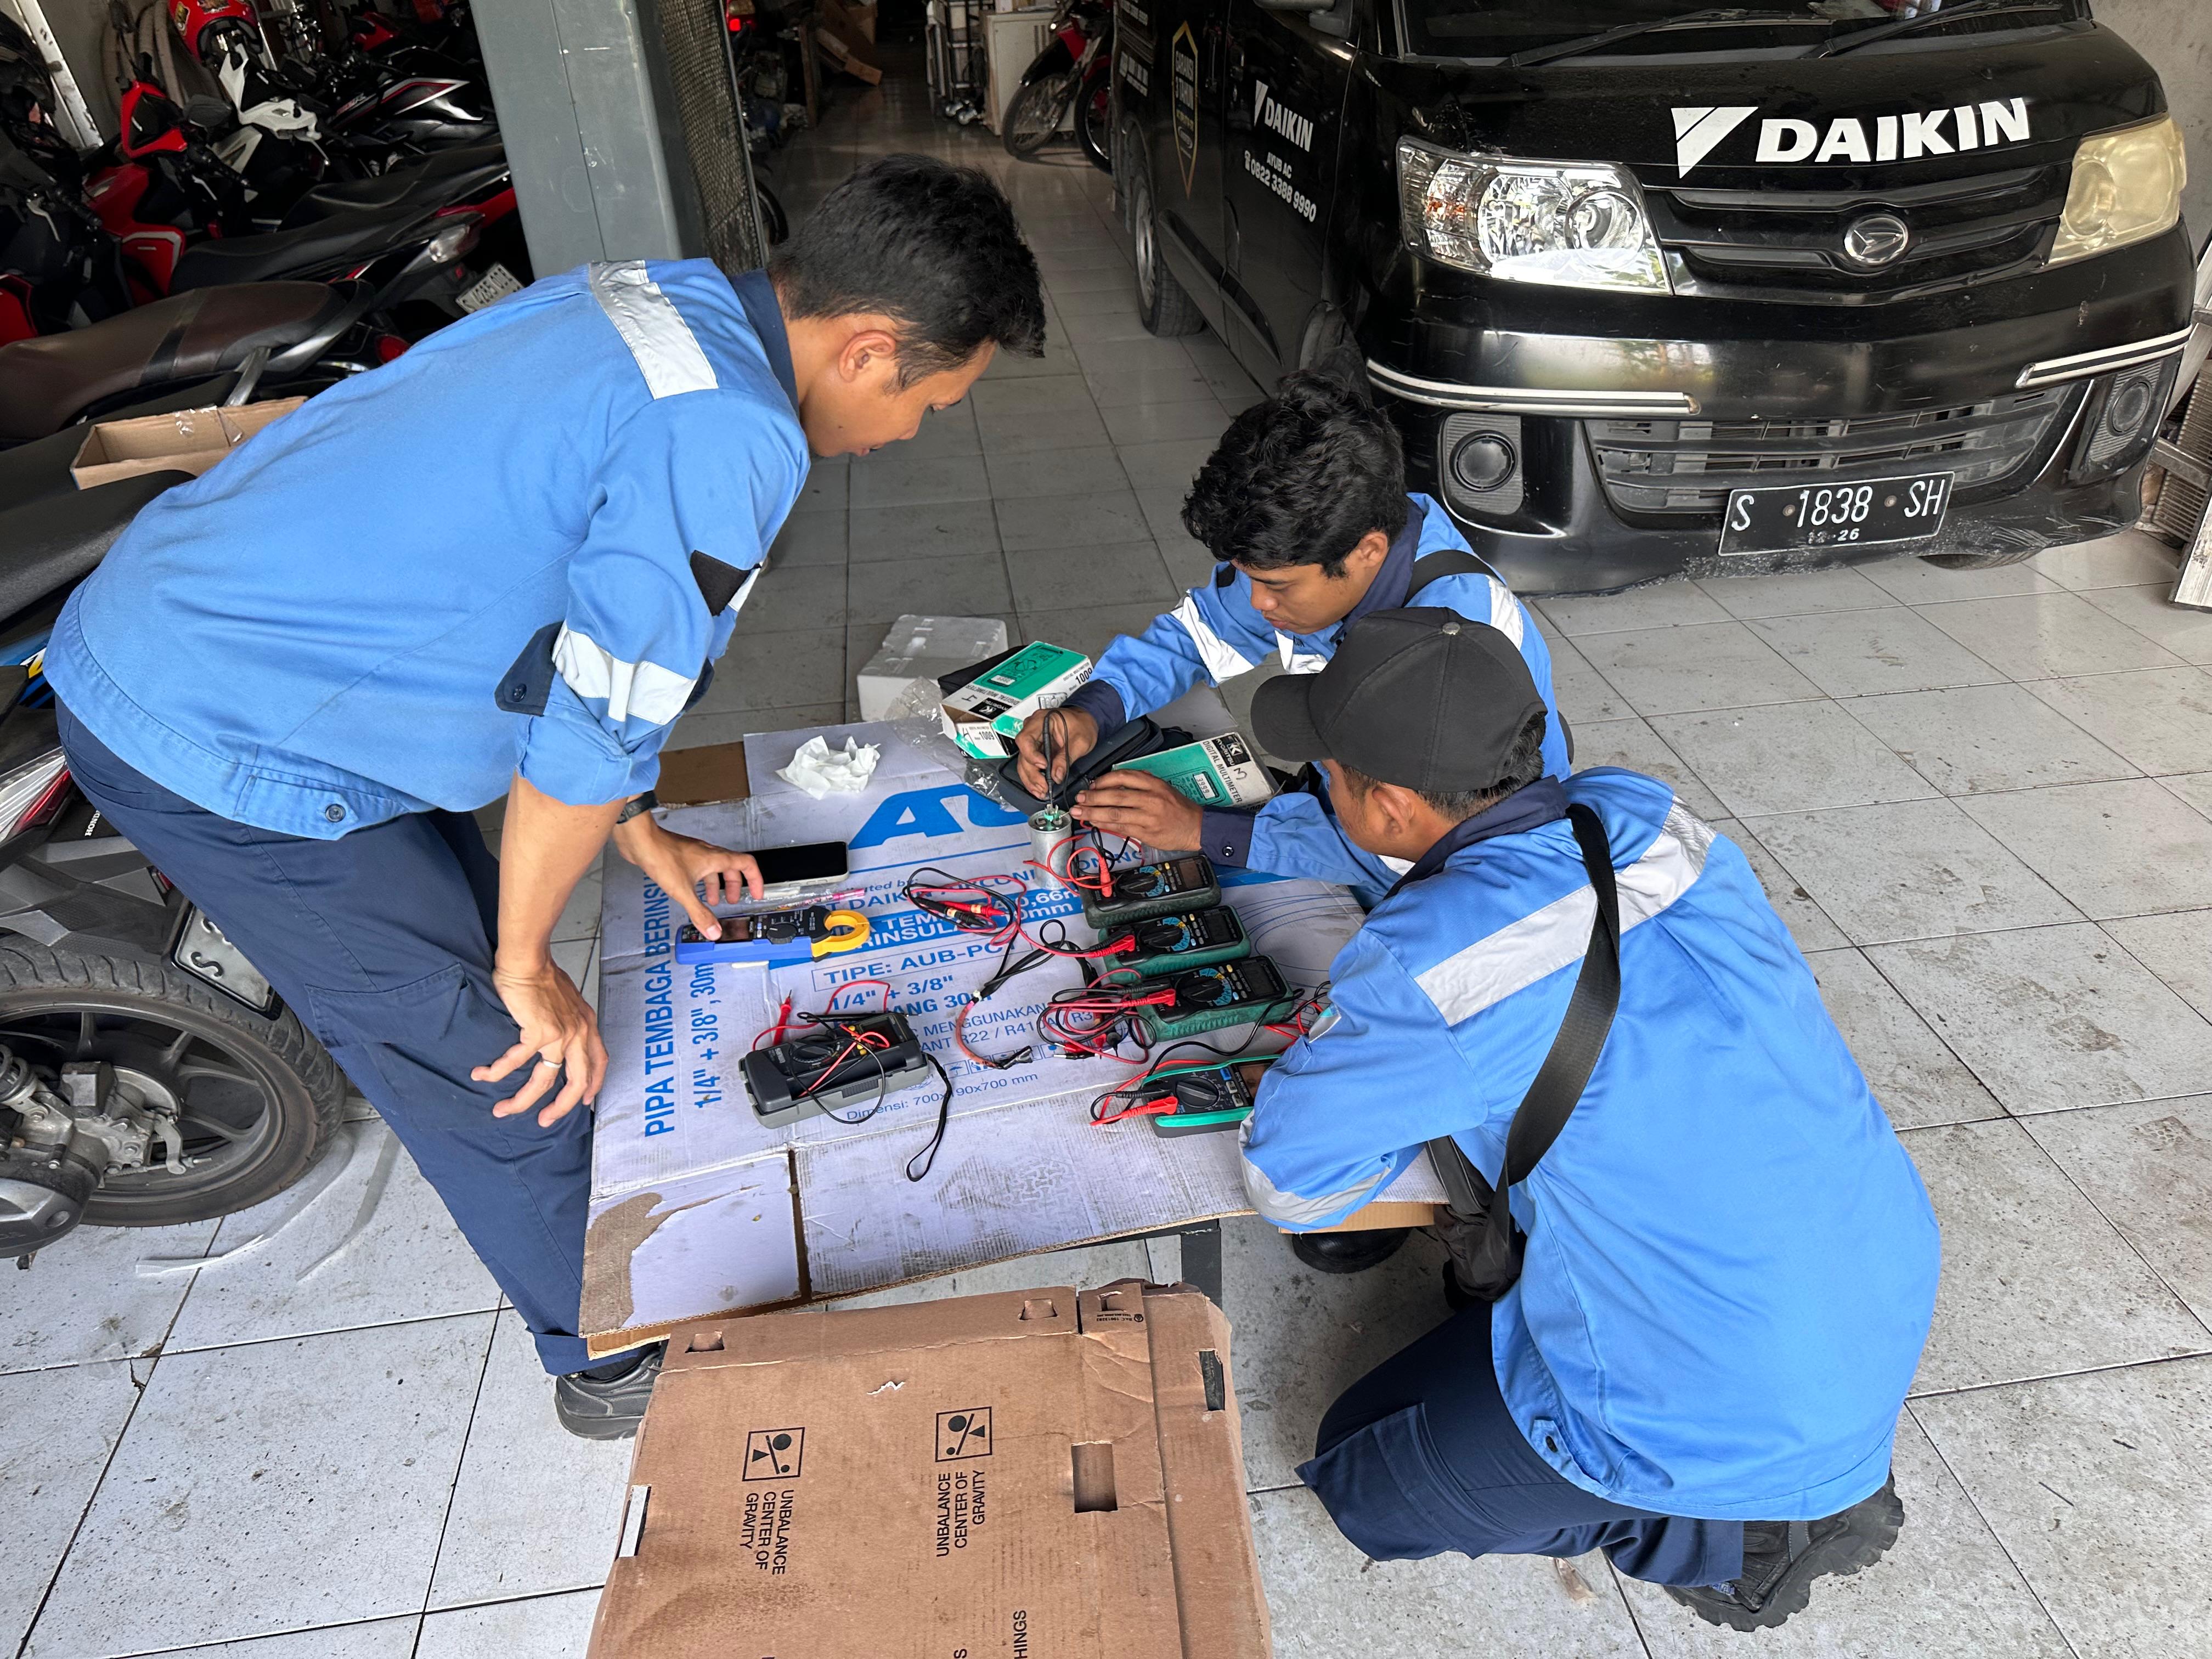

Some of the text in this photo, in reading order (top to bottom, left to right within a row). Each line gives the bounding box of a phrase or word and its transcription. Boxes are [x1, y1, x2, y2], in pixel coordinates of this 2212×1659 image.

[1265, 97, 1313, 153] DAIKIN
[1756, 98, 2030, 162] DAIKIN
[1251, 159, 1316, 222] 0822 3388 9990
[1283, 163, 1292, 179] AC
[1731, 479, 1945, 531] S 1838 SH
[1838, 528, 1860, 541] 26
[1203, 741, 1243, 803] DIGITAL MULTIMETER
[1216, 738, 1235, 766] KYORITSU
[84, 810, 101, 836] HOND
[191, 951, 224, 977] S
[690, 963, 715, 998] 30m
[823, 962, 891, 984] TIPE:
[907, 975, 953, 995] 3/8"
[645, 960, 674, 1075] TEMBAGA
[645, 1076, 675, 1137] PIPA
[847, 1099, 909, 1120] Dimensi:
[1012, 1073, 1039, 1085] mm
[740, 1493, 759, 1549] GRAVITY
[936, 1473, 951, 1557] UNBALANCE
[955, 1472, 968, 1549] CENTER OF
[973, 1470, 985, 1525] GRAVITY
[755, 1491, 776, 1570] CENTER OF
[772, 1489, 794, 1575] UNBALANCE
